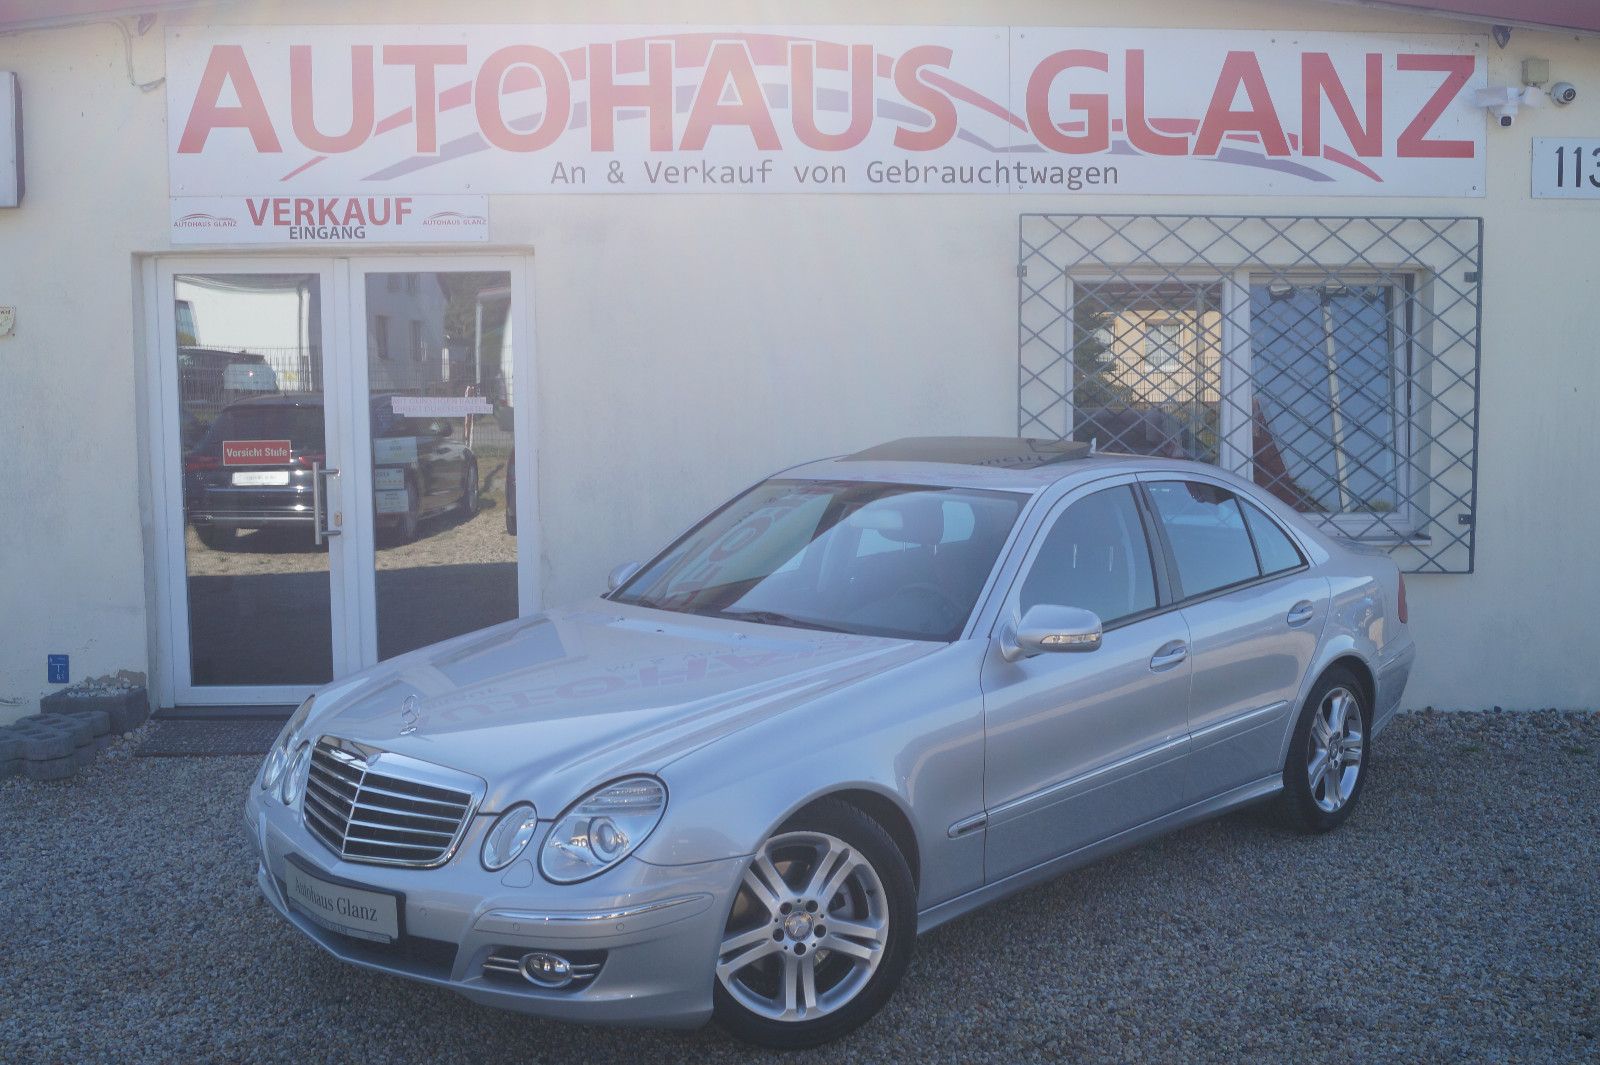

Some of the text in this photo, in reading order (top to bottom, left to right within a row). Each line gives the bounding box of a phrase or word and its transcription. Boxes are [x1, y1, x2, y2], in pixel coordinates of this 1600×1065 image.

[178, 43, 1476, 159] AUTOHAUS GLANZ
[550, 159, 1119, 191] An & Verkauf von Gebrauchtwagen
[245, 197, 413, 227] VERKAUF
[422, 218, 487, 226] AUTOHAUS GLANZ
[173, 220, 237, 228] AUTOHAUS GLANZ
[289, 226, 366, 240] EINGANG
[226, 446, 288, 458] Vorsicht Stufe
[295, 877, 334, 912] Autohaus
[336, 897, 378, 922] Glanz
